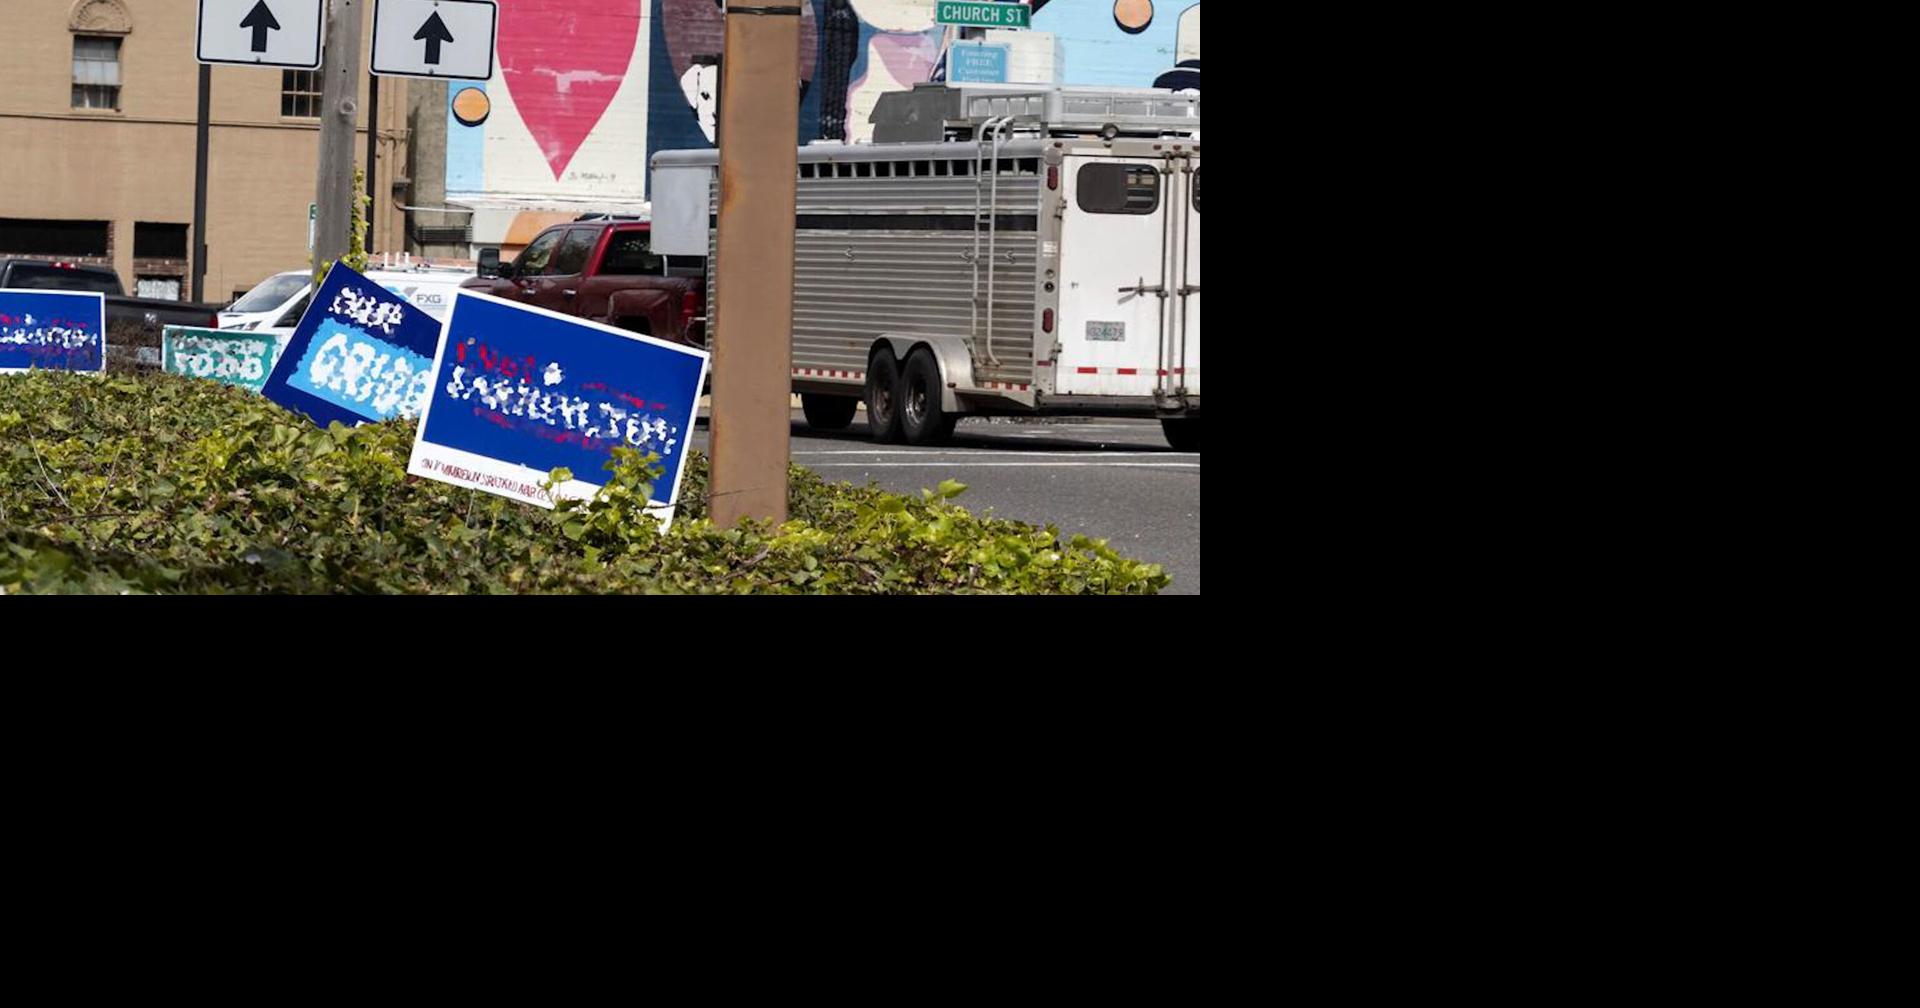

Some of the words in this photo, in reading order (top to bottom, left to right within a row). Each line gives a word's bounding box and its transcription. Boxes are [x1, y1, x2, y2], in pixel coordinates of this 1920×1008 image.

[942, 5, 999, 22] CHURCH
[1006, 8, 1023, 23] ST
[416, 294, 441, 304] FXG
